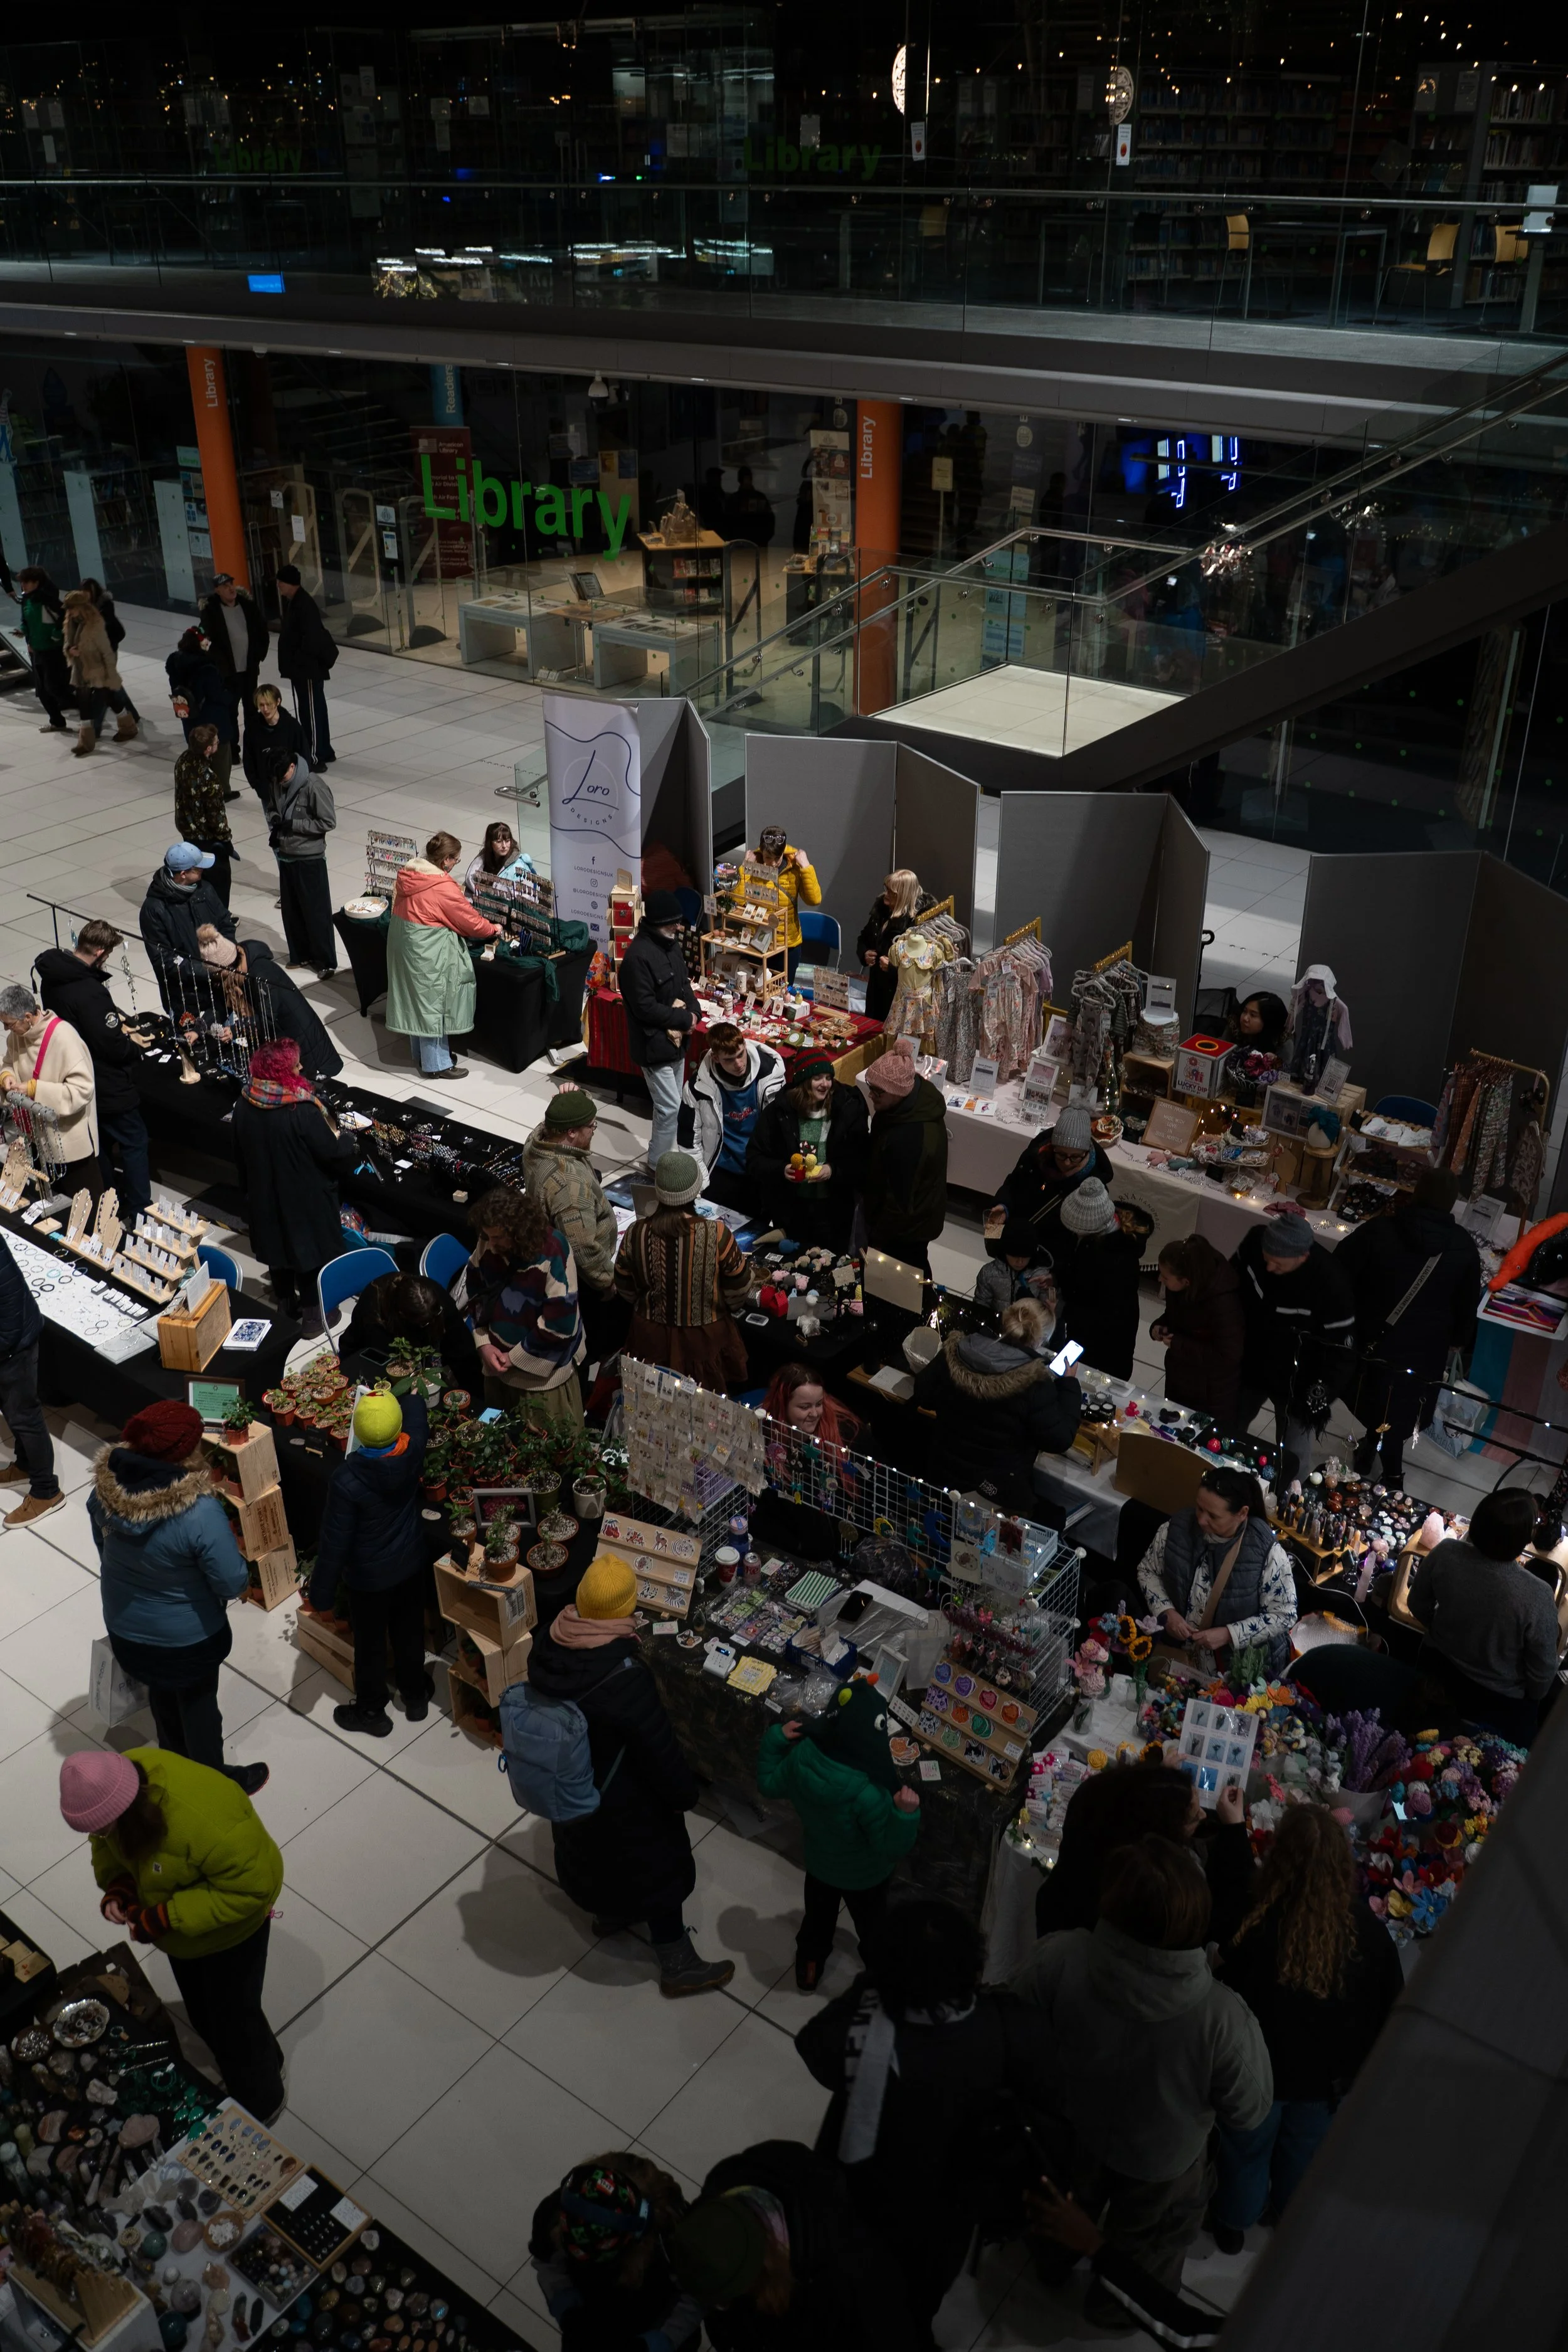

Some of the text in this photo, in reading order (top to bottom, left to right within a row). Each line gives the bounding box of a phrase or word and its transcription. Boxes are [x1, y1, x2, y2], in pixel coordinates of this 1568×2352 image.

[215, 142, 302, 174] Library
[743, 136, 882, 181] Library
[207, 358, 216, 408] Library
[445, 364, 457, 414] Readers
[861, 416, 876, 479] Library
[420, 453, 631, 561] Library
[562, 750, 619, 810] Loro
[570, 807, 613, 826] DESIGNS
[574, 866, 613, 877] LORODESIGNSUK
[1177, 1079, 1196, 1089] LUCKY
[1118, 1193, 1161, 1231] RYA HANDMADE
[1394, 1264, 1433, 1316] LULUCASTAGNETTE
